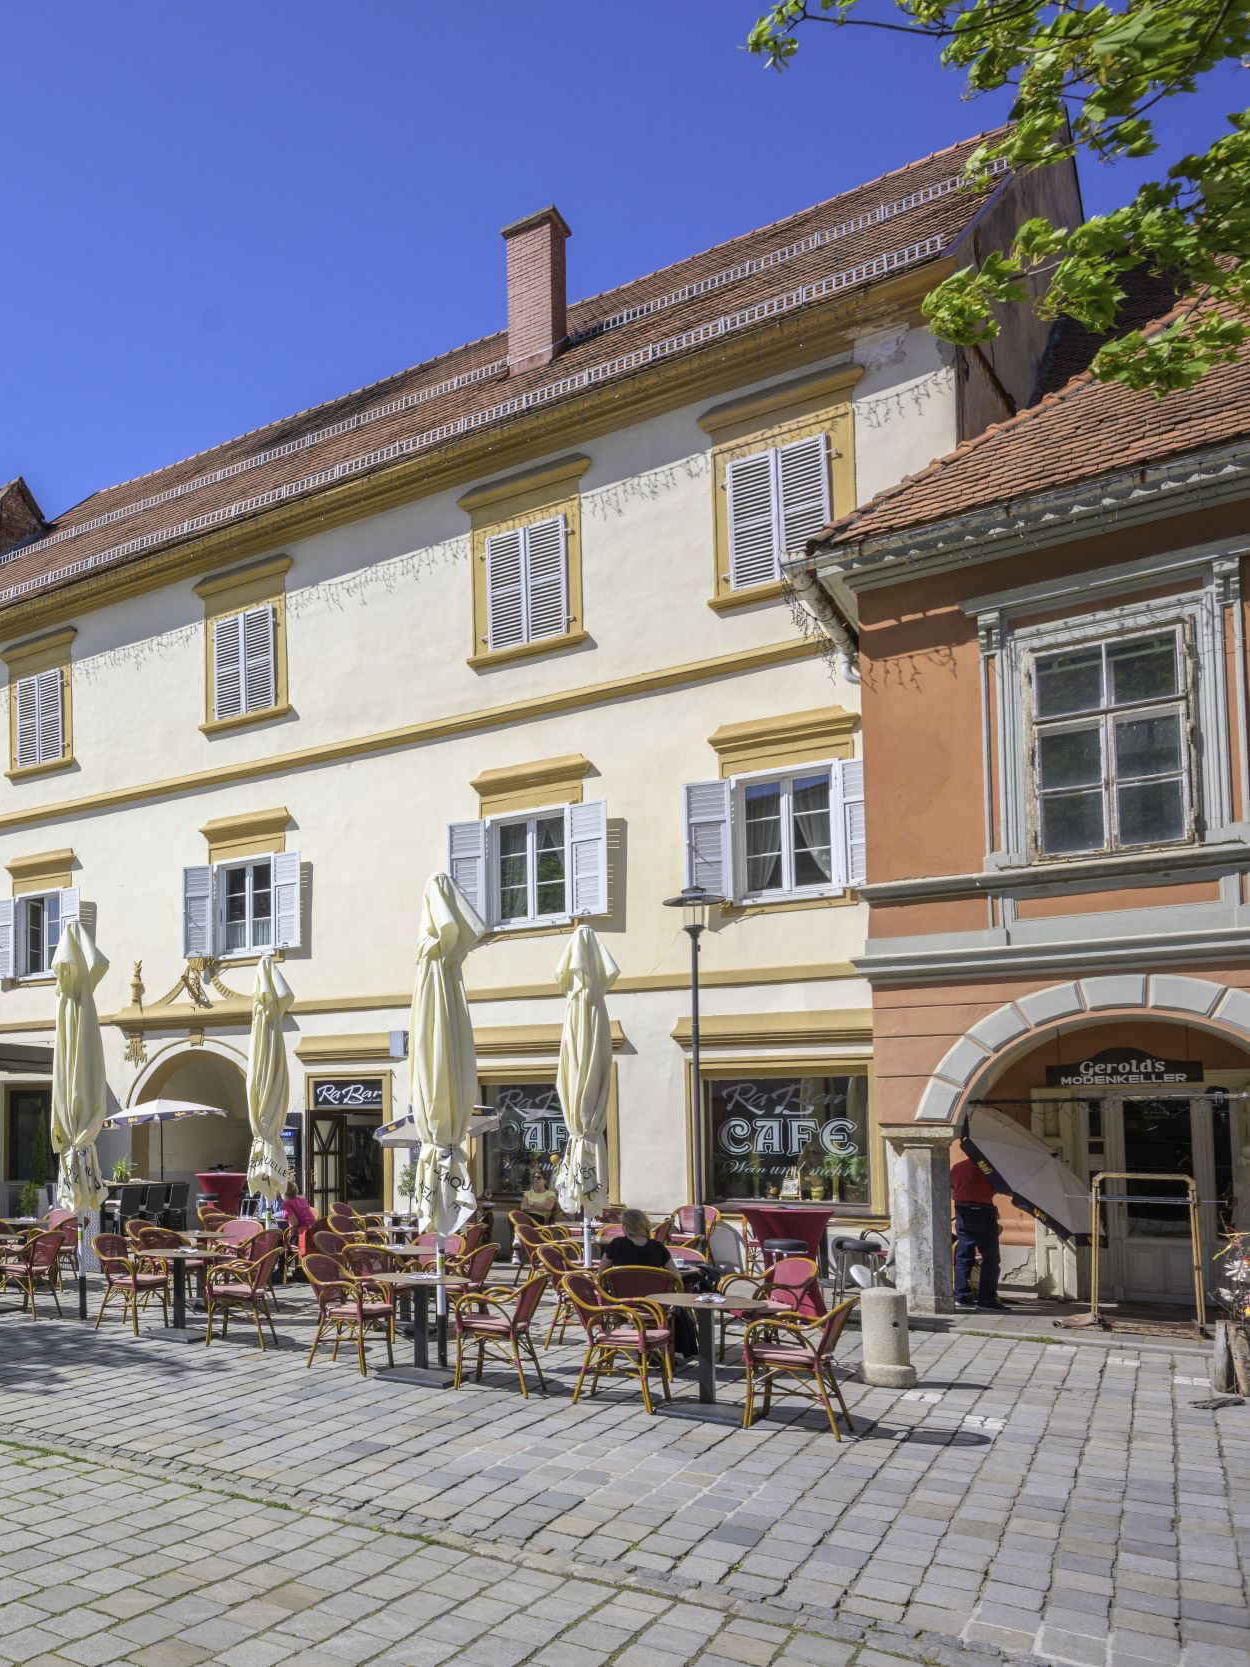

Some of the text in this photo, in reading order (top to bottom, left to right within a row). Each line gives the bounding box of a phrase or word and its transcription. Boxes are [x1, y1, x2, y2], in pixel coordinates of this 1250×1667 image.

[1079, 1059, 1166, 1077] Gerold's
[1061, 1074, 1187, 1085] MODENKELLER
[718, 1117, 859, 1157] CAFE
